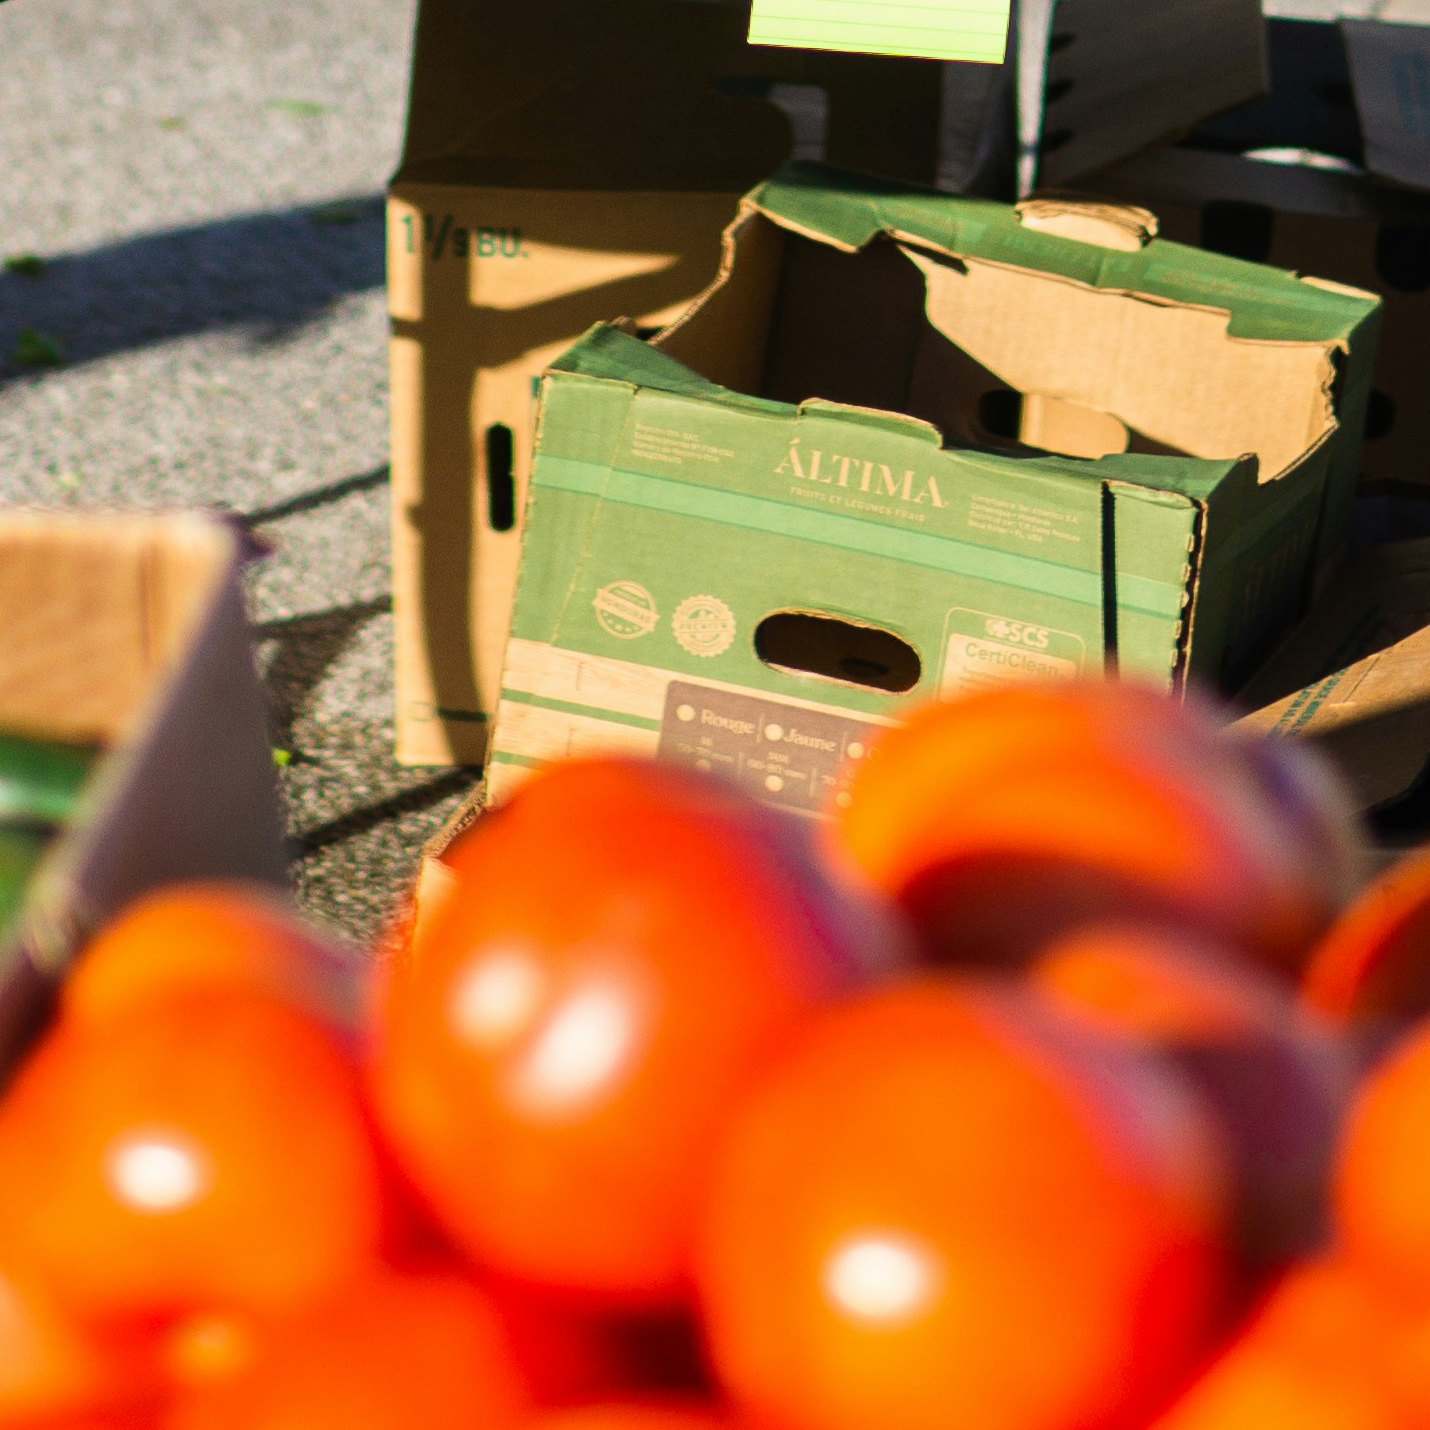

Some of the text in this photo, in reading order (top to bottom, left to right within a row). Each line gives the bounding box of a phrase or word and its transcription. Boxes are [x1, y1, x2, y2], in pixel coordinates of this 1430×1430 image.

[476, 225, 530, 259] BU.
[772, 436, 946, 510] ÁLTIMA
[1008, 622, 1049, 650] SCS
[701, 708, 837, 753] Rouge Jaune
